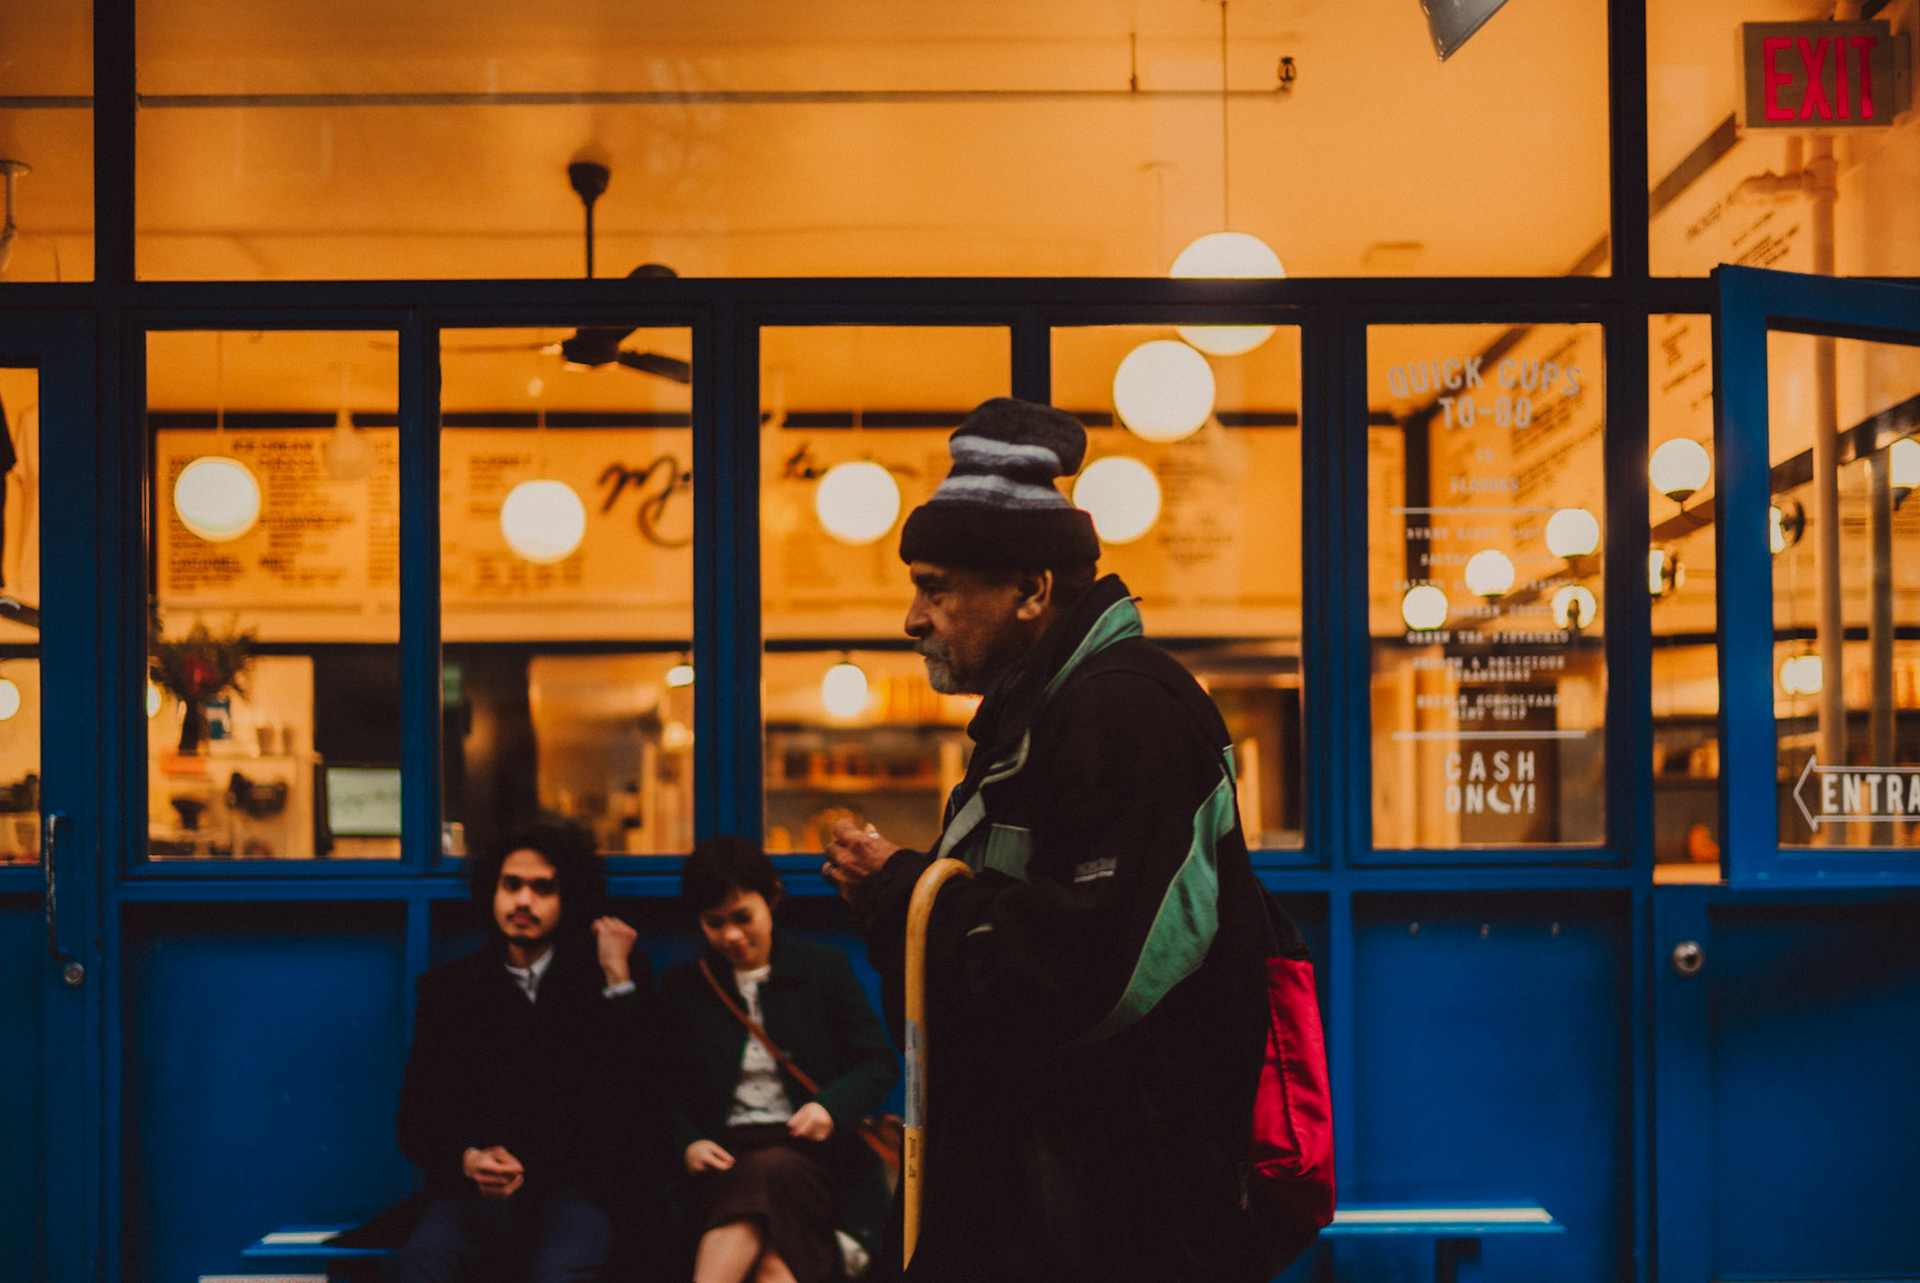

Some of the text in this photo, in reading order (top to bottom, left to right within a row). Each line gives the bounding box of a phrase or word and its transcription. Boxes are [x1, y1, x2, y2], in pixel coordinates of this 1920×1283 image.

[1763, 36, 1877, 121] EXIT
[1389, 357, 1581, 397] QUICK CUPS
[1438, 396, 1533, 429] TO-GO
[1450, 477, 1519, 493] FLAVORS
[1457, 630, 1485, 644] TEA
[1445, 751, 1536, 782] CASH
